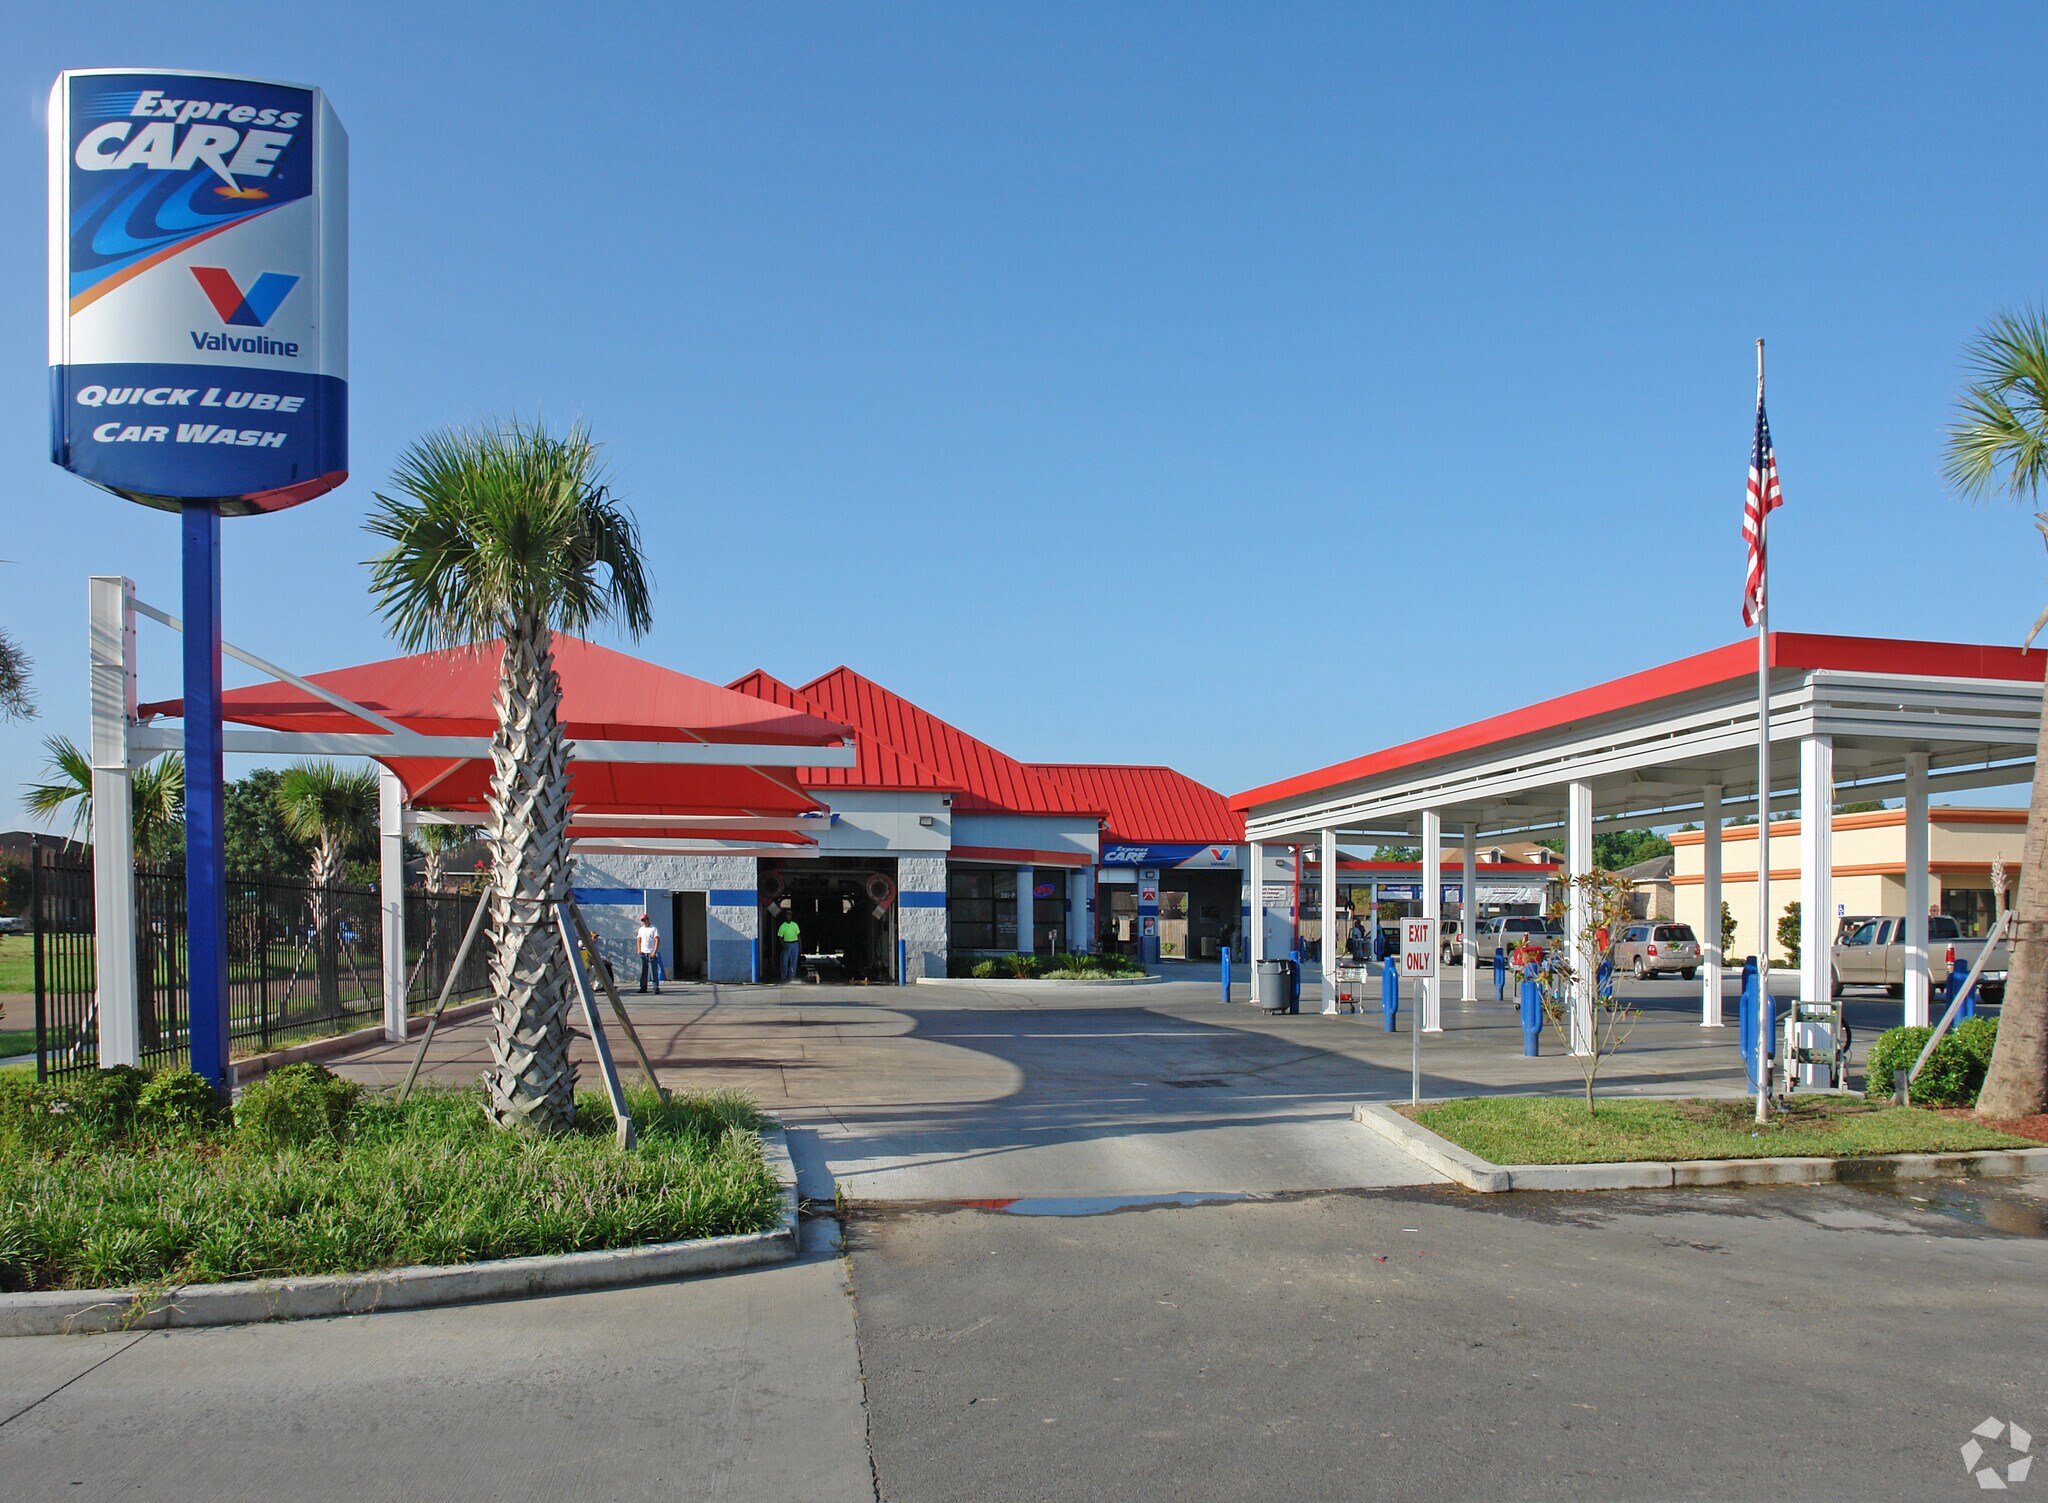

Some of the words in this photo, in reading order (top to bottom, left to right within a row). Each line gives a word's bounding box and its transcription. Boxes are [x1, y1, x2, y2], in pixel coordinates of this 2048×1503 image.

[130, 90, 303, 128] Express
[74, 121, 293, 192] CARE
[190, 331, 299, 357] Valvoline
[76, 385, 199, 408] QUICK
[200, 387, 306, 413] LUBE
[92, 422, 170, 443] CAR
[175, 423, 288, 448] WASH
[1104, 851, 1147, 865] CARE
[1408, 924, 1428, 942] EXIT
[1406, 952, 1430, 970] ONLY
